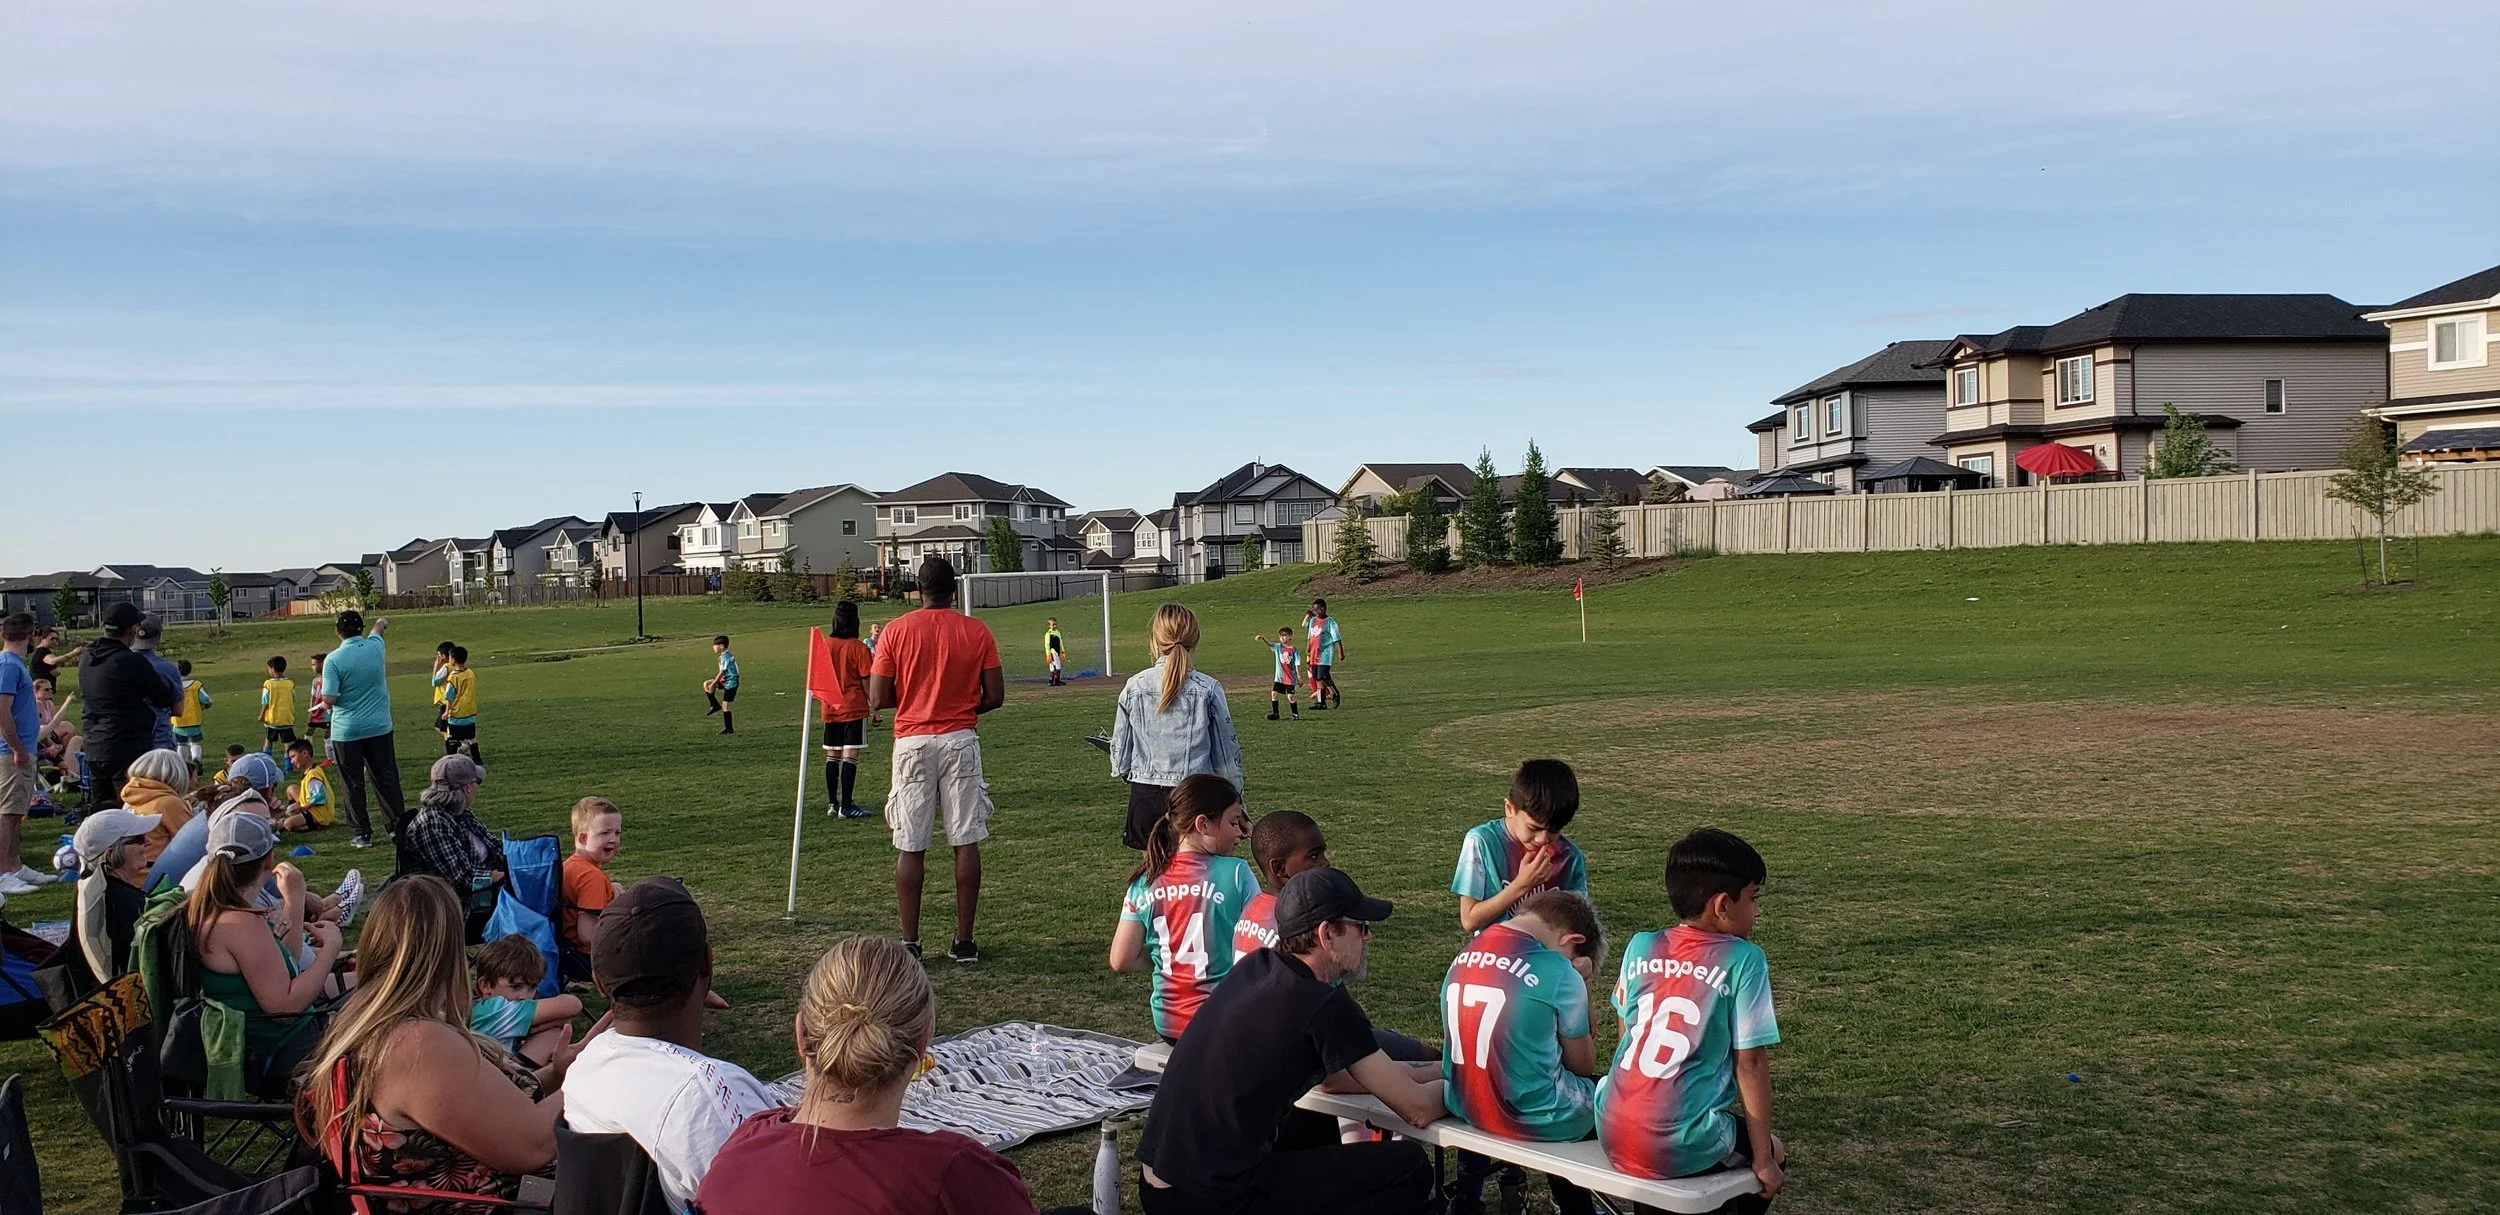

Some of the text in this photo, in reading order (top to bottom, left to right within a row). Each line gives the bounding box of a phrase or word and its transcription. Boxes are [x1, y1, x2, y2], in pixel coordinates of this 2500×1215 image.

[1137, 881, 1225, 911] Chappelle
[1153, 912, 1209, 979] 14
[1234, 919, 1280, 949] appell
[1451, 951, 1539, 988] appelle
[1627, 956, 1730, 998] Chappelle
[1446, 982, 1506, 1070] 17
[1620, 992, 1701, 1080] 16
